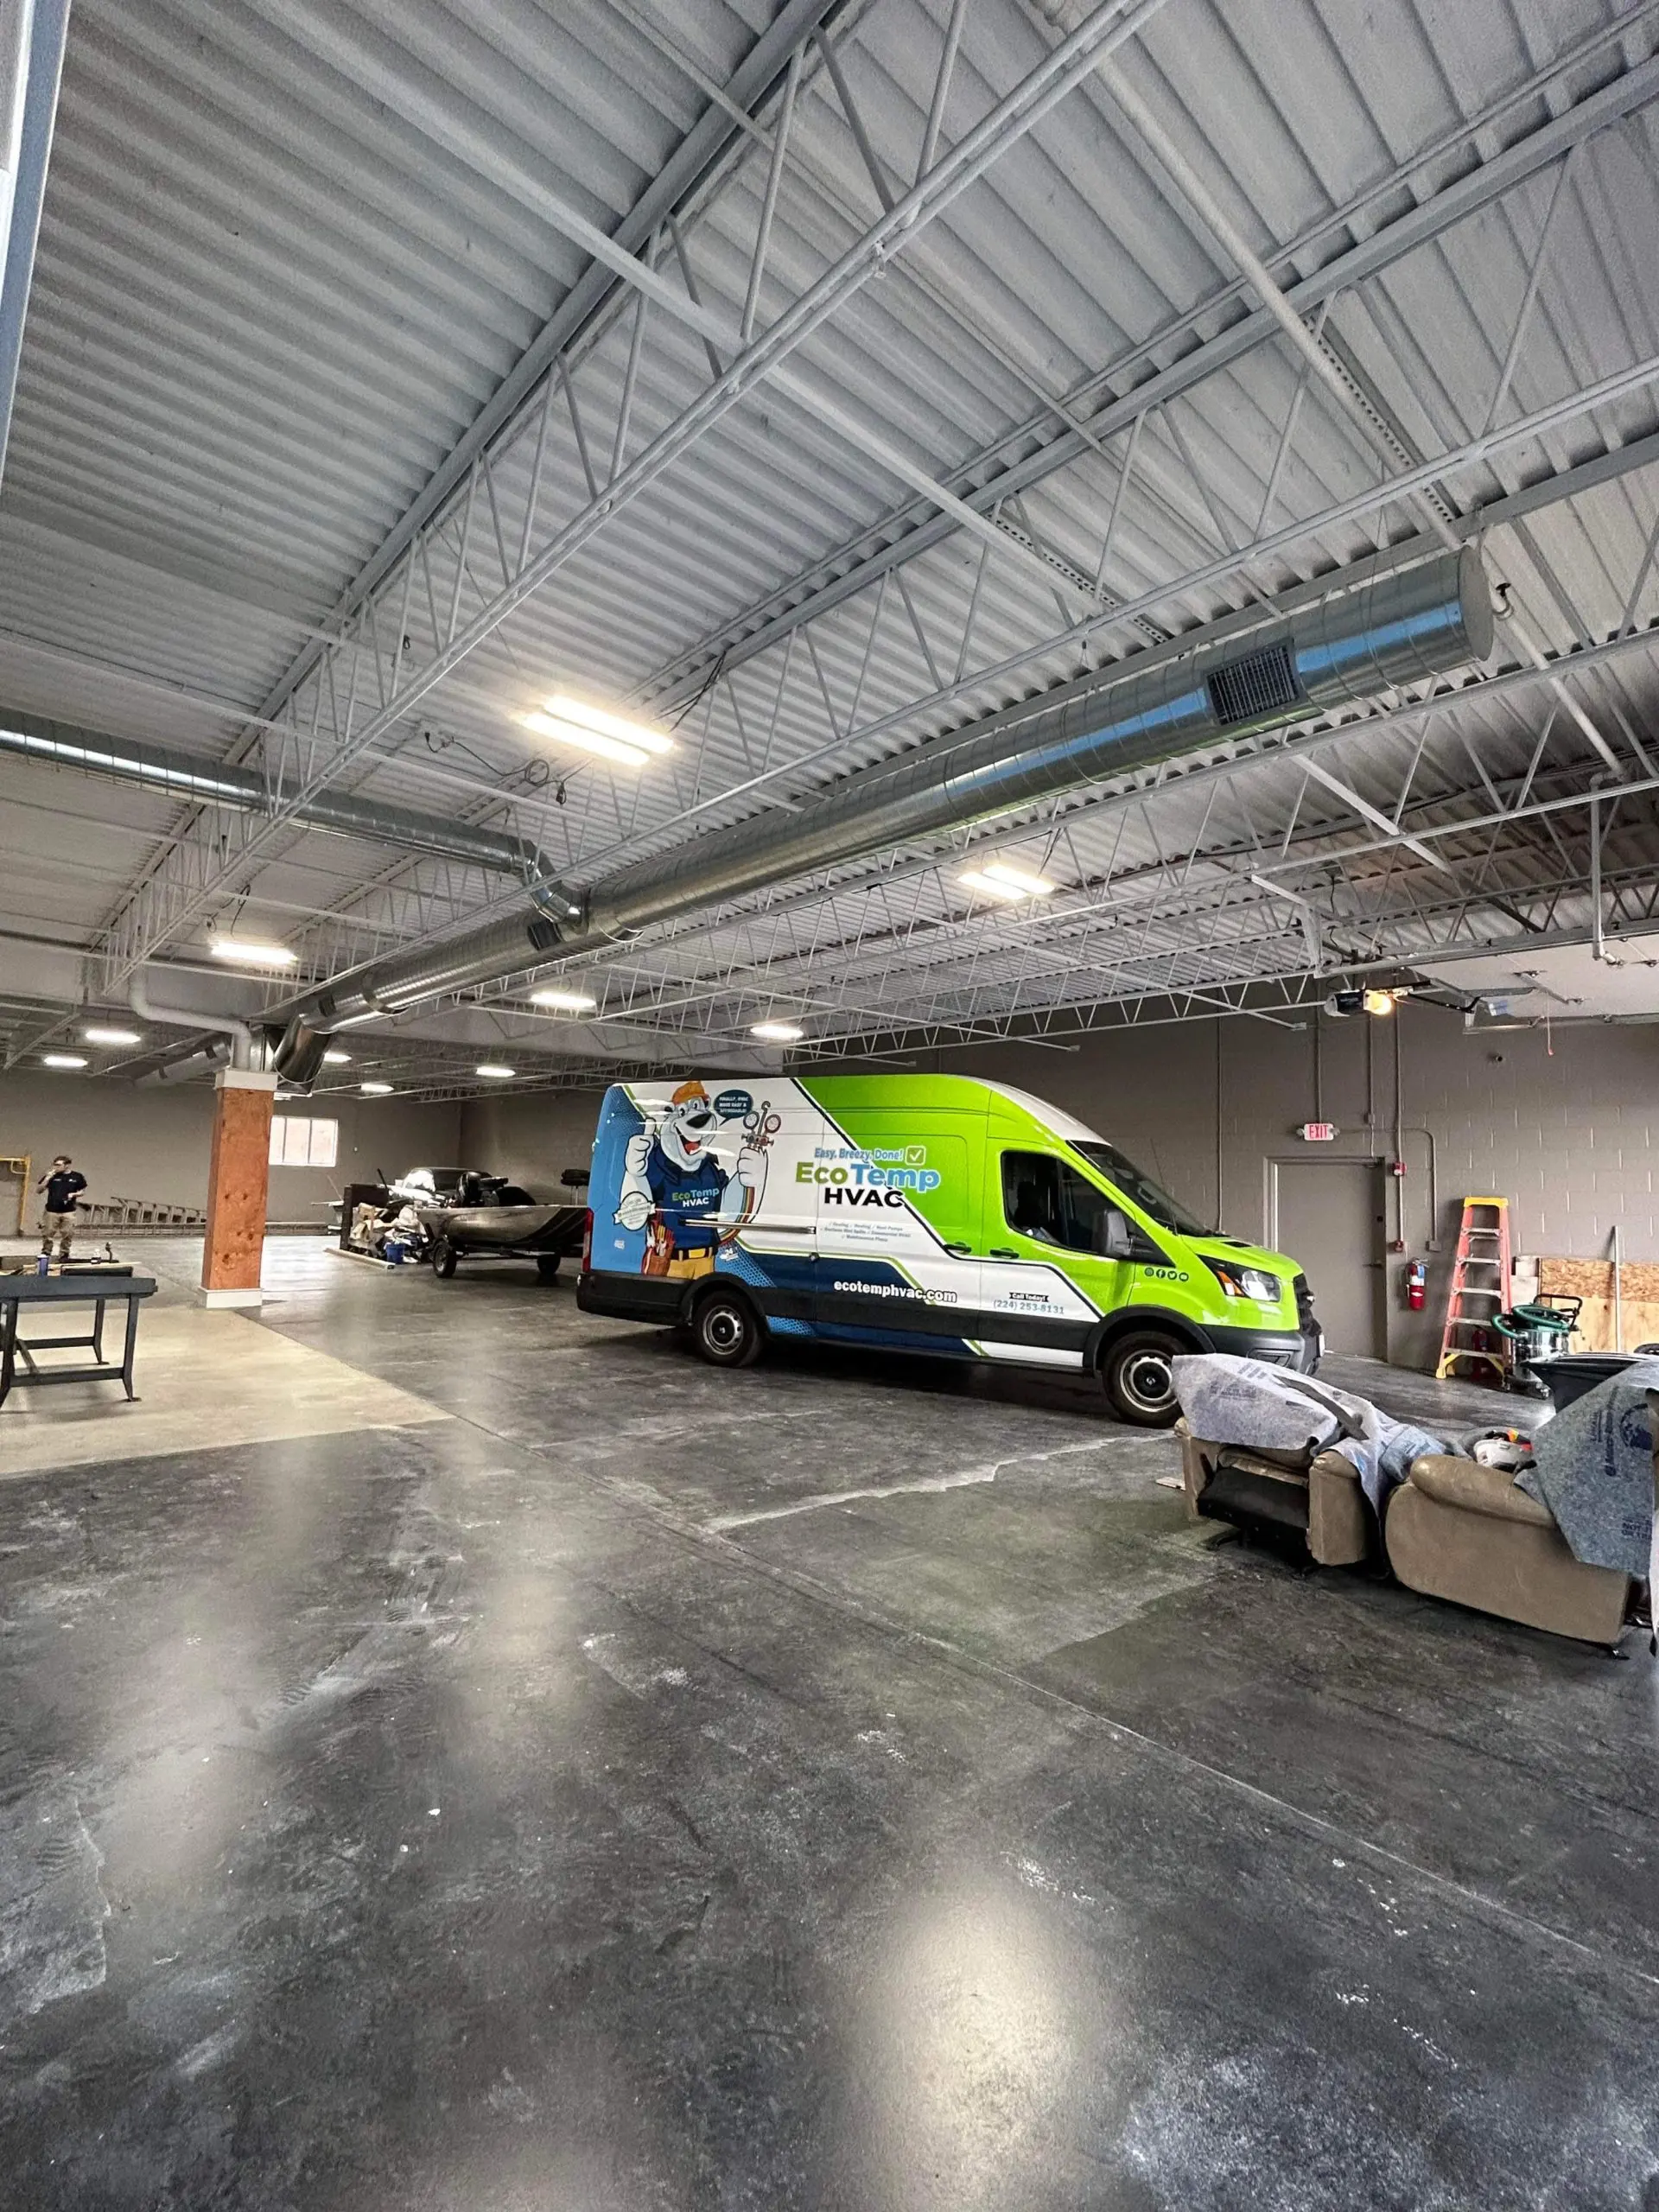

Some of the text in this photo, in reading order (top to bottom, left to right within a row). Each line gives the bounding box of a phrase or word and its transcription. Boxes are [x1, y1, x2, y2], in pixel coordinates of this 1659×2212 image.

[1309, 1124, 1328, 1139] EXIT
[874, 1149, 904, 1160] Done!
[683, 1197, 709, 1208] HVAC
[823, 1187, 905, 1208] HVAC
[834, 1281, 957, 1302] ecotemphvac.com
[993, 1299, 1065, 1314] (224) 253-8131
